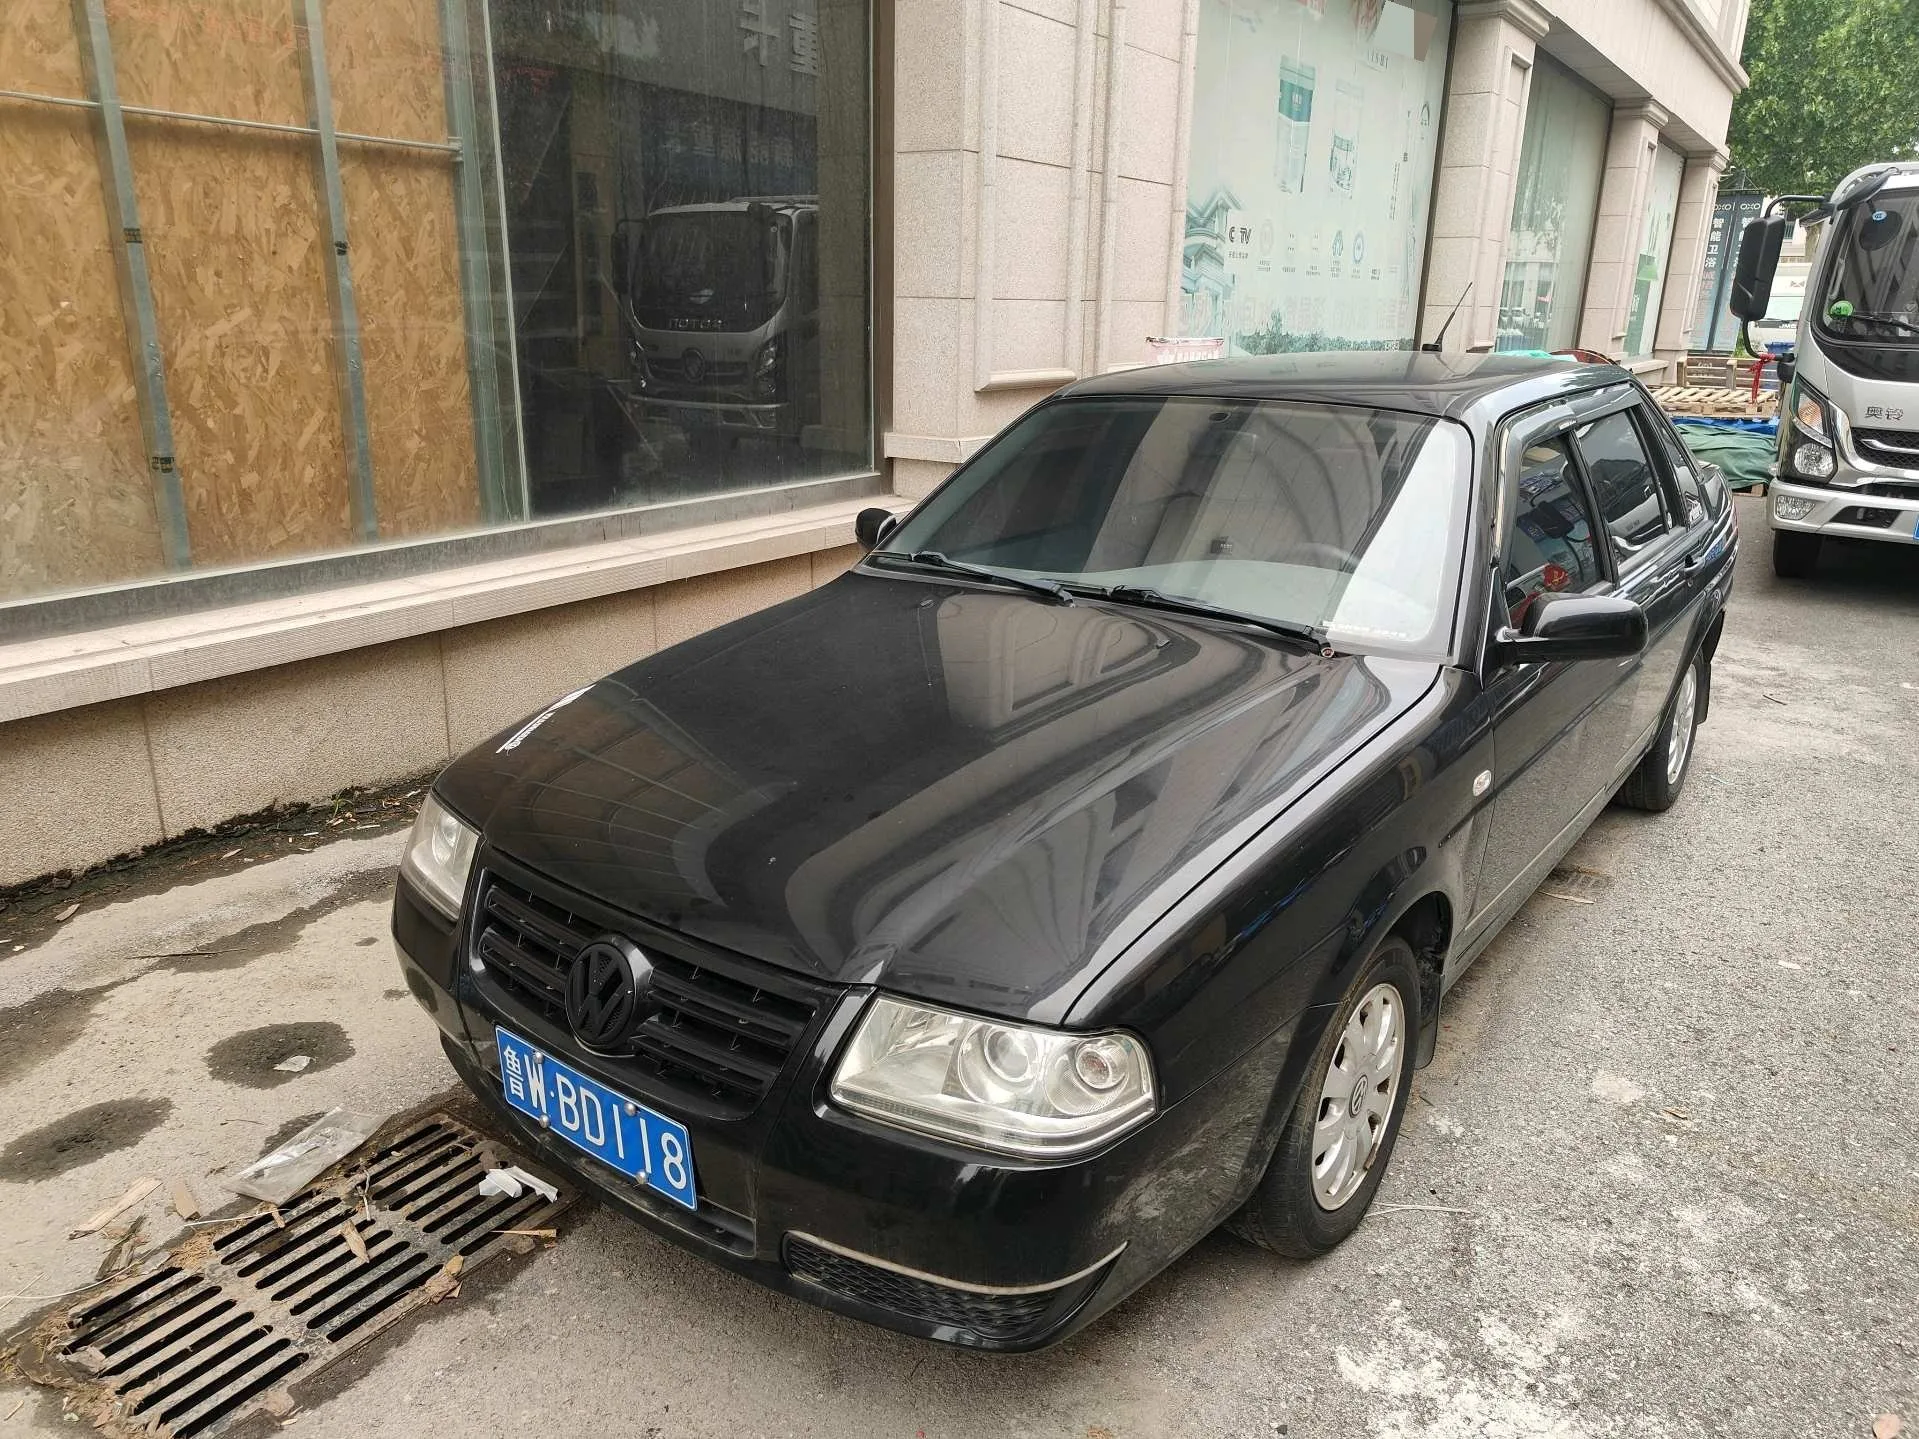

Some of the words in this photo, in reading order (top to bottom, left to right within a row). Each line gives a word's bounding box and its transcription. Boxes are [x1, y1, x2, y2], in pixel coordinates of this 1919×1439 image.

[1740, 202, 1761, 210] OXO
[1705, 218, 1724, 268] 智能卫浴
[1864, 406, 1904, 421] 奥铃
